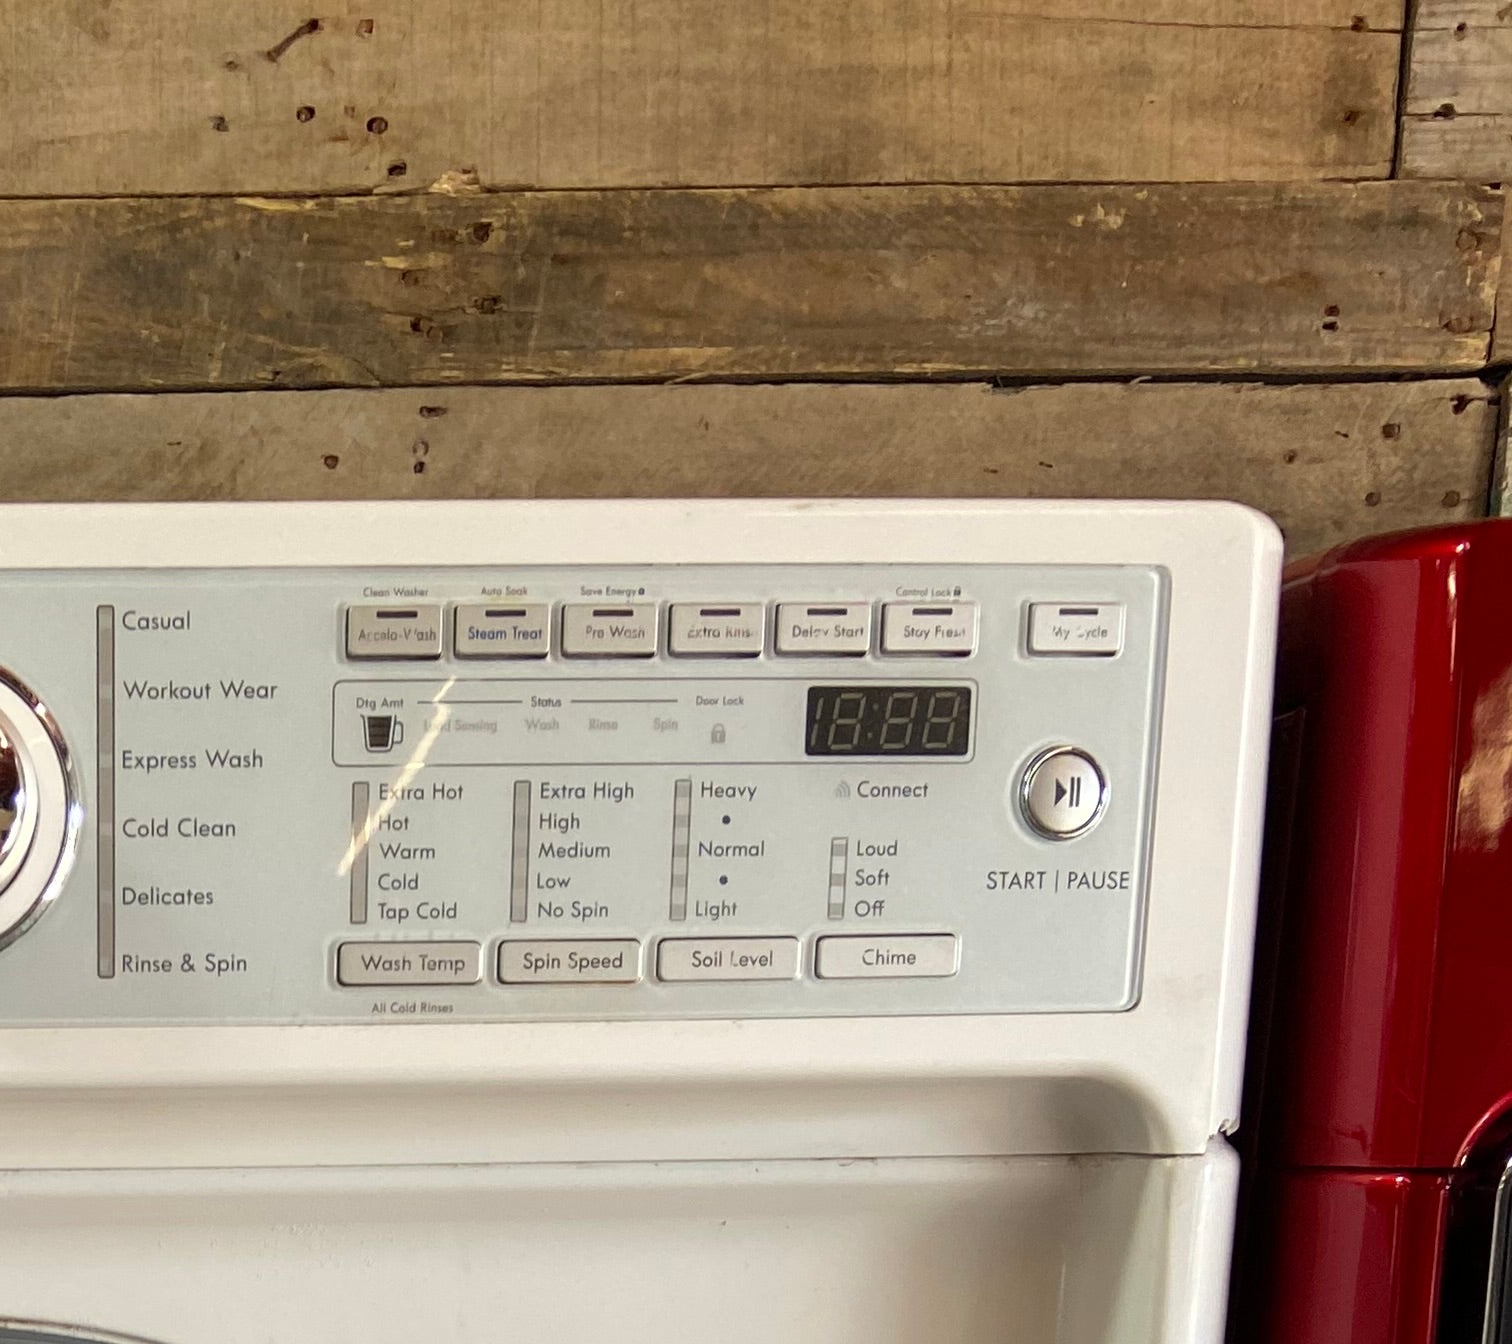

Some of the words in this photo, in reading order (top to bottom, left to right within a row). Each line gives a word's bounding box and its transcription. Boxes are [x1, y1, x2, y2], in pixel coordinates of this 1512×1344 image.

[363, 587, 390, 597] Clean
[393, 587, 429, 597] Washer
[481, 586, 502, 596] Auto
[505, 586, 527, 596] Soak
[580, 586, 602, 596] Save
[605, 586, 636, 598] Energy
[896, 587, 928, 597] Control
[931, 587, 951, 597] Lock
[122, 610, 191, 631] Casual
[468, 626, 507, 640] Steam
[512, 626, 542, 640] Treat
[609, 625, 646, 640] Wash
[833, 625, 864, 638] Start
[904, 626, 930, 640] Stay
[123, 680, 212, 700] Workout
[219, 680, 278, 700] Wear
[356, 697, 377, 711] Dtg
[381, 697, 404, 708] Amt
[531, 696, 562, 708] Status
[696, 696, 719, 706] Door
[723, 696, 745, 706] Lock
[525, 719, 560, 731] Wash
[588, 719, 619, 731] Rinse
[653, 718, 678, 733] Spin
[122, 749, 196, 774] Express
[205, 748, 263, 769] Wash
[379, 783, 425, 800] Extra
[433, 783, 463, 800] Hot
[540, 783, 585, 799] Extra
[593, 782, 634, 803] High
[700, 782, 757, 802] Heavy
[857, 781, 929, 799] Connect
[122, 818, 168, 838] Cold
[177, 818, 236, 838] Clean
[379, 814, 409, 831] Hot
[539, 813, 580, 834] High
[379, 842, 436, 860] Warm
[538, 843, 611, 859] Medium
[698, 841, 765, 858] Normal
[857, 840, 898, 858] Loud
[378, 873, 419, 891] Cold
[537, 874, 571, 889] Low
[854, 870, 890, 887] Soft
[986, 871, 1046, 890] START
[1067, 871, 1130, 890] PAUSE
[122, 887, 214, 906] Delicates
[378, 902, 409, 924] Tap
[416, 902, 457, 919] Cold
[537, 903, 564, 918] No
[571, 901, 609, 922] Spin
[695, 901, 738, 920] Light
[854, 901, 886, 918] Off
[122, 954, 172, 973] Rinse
[180, 955, 195, 973] &
[204, 954, 247, 977] Spin
[361, 954, 411, 972] Wash
[418, 954, 465, 976] Temp
[523, 952, 561, 973] Spin
[568, 952, 623, 973] Speed
[691, 950, 723, 968] Soil
[730, 950, 774, 968] Level
[862, 948, 917, 967] Chime
[372, 1001, 387, 1014] All
[390, 1001, 417, 1014] Cold
[420, 1001, 454, 1014] Rinses
